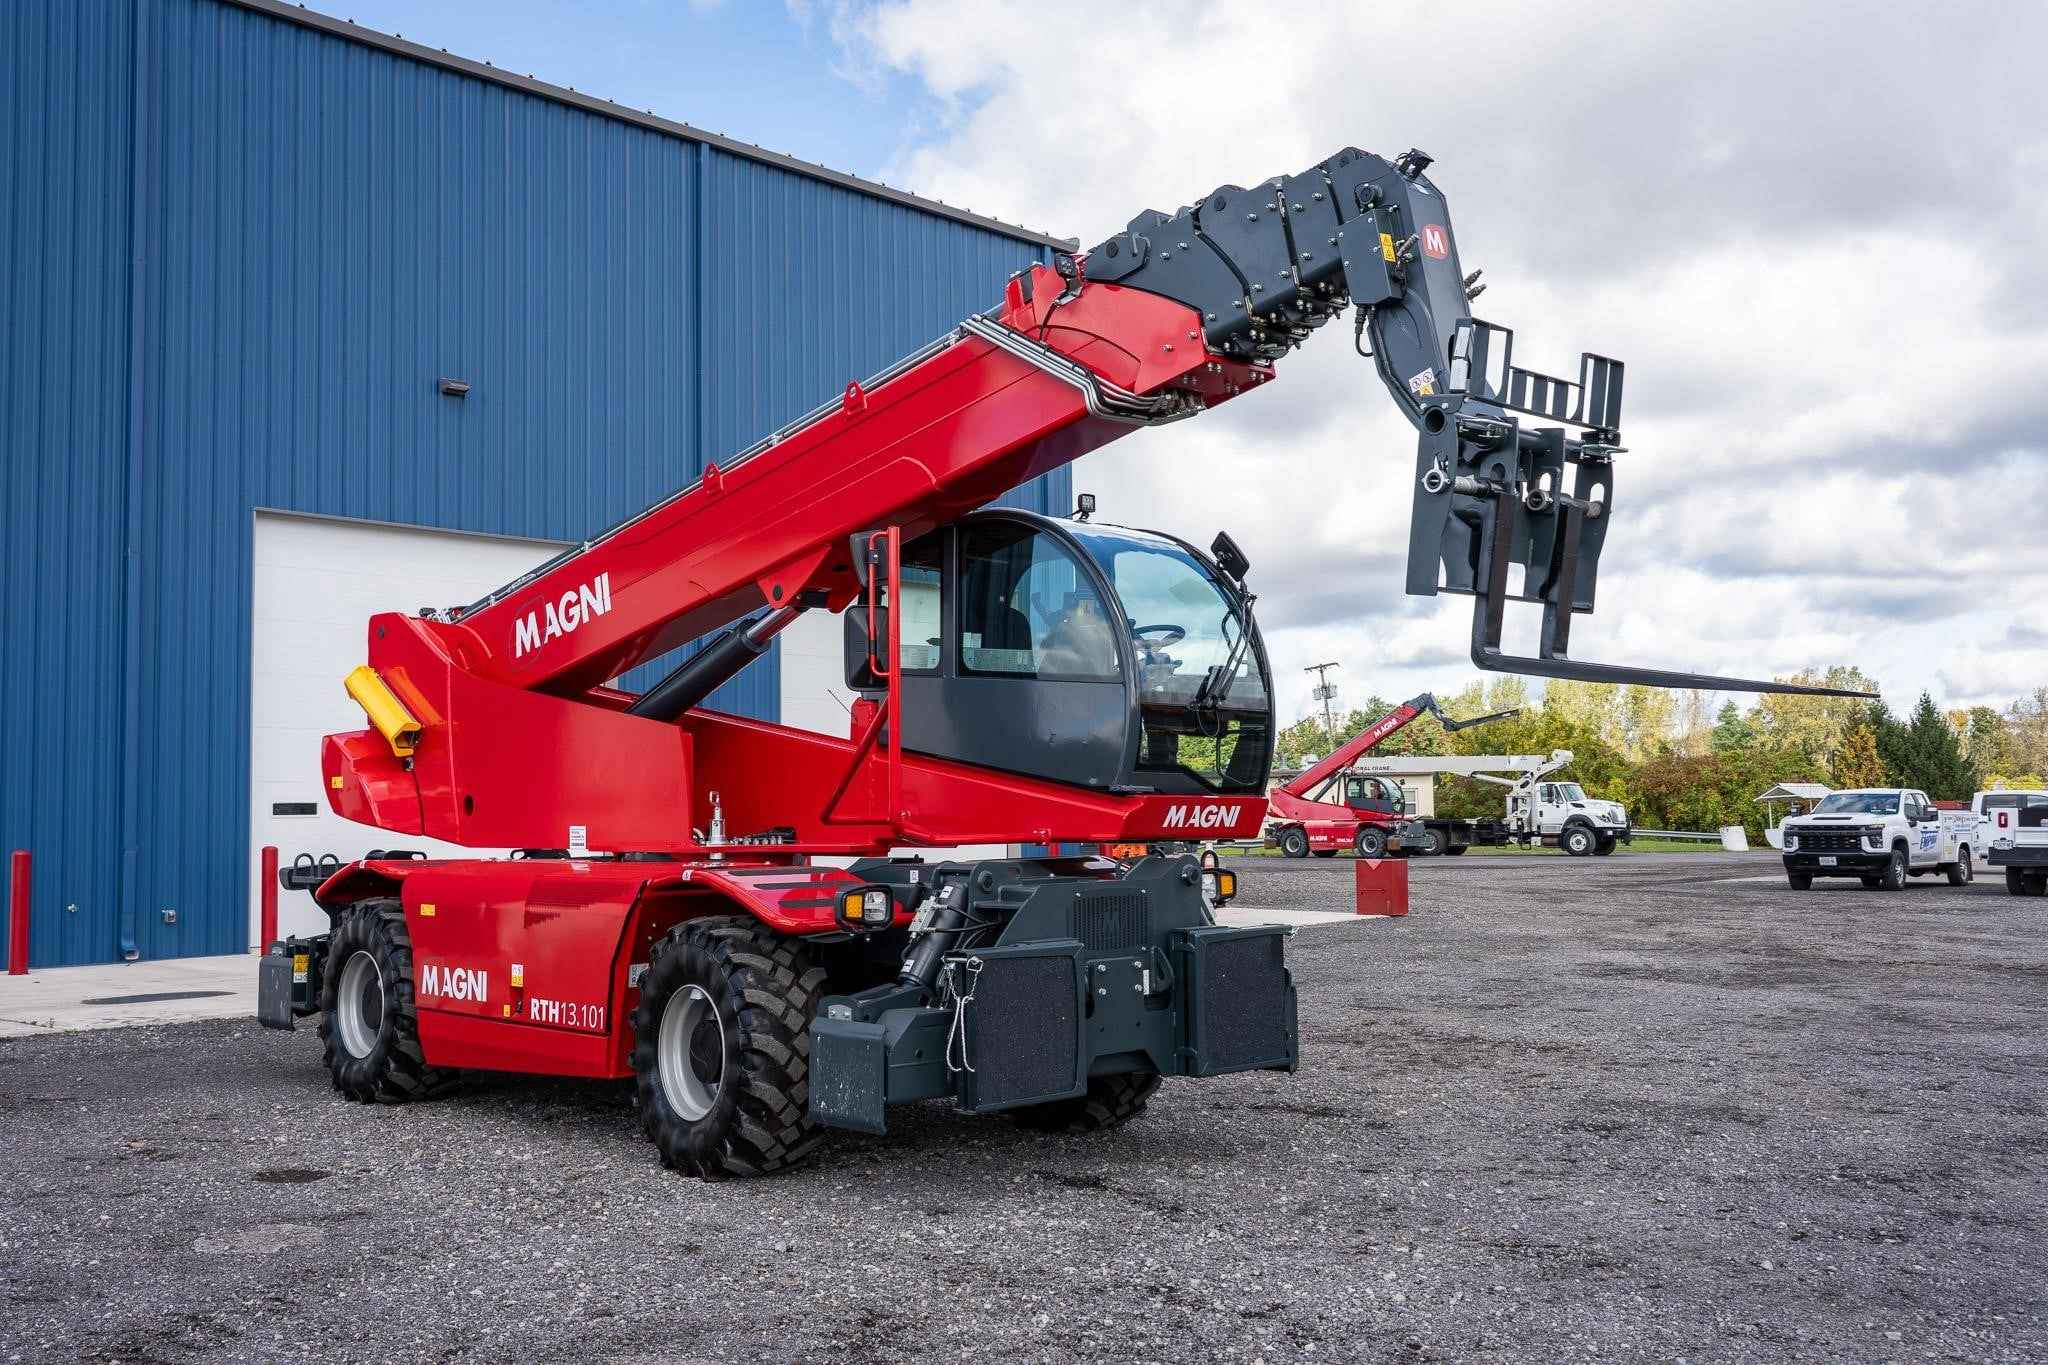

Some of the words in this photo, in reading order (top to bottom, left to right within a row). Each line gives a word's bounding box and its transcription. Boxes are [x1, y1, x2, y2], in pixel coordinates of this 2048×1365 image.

[514, 572, 613, 657] MAGNI
[1162, 805, 1241, 828] MAGNI
[421, 964, 488, 1003] MAGNI
[530, 998, 605, 1030] RTH13.101
